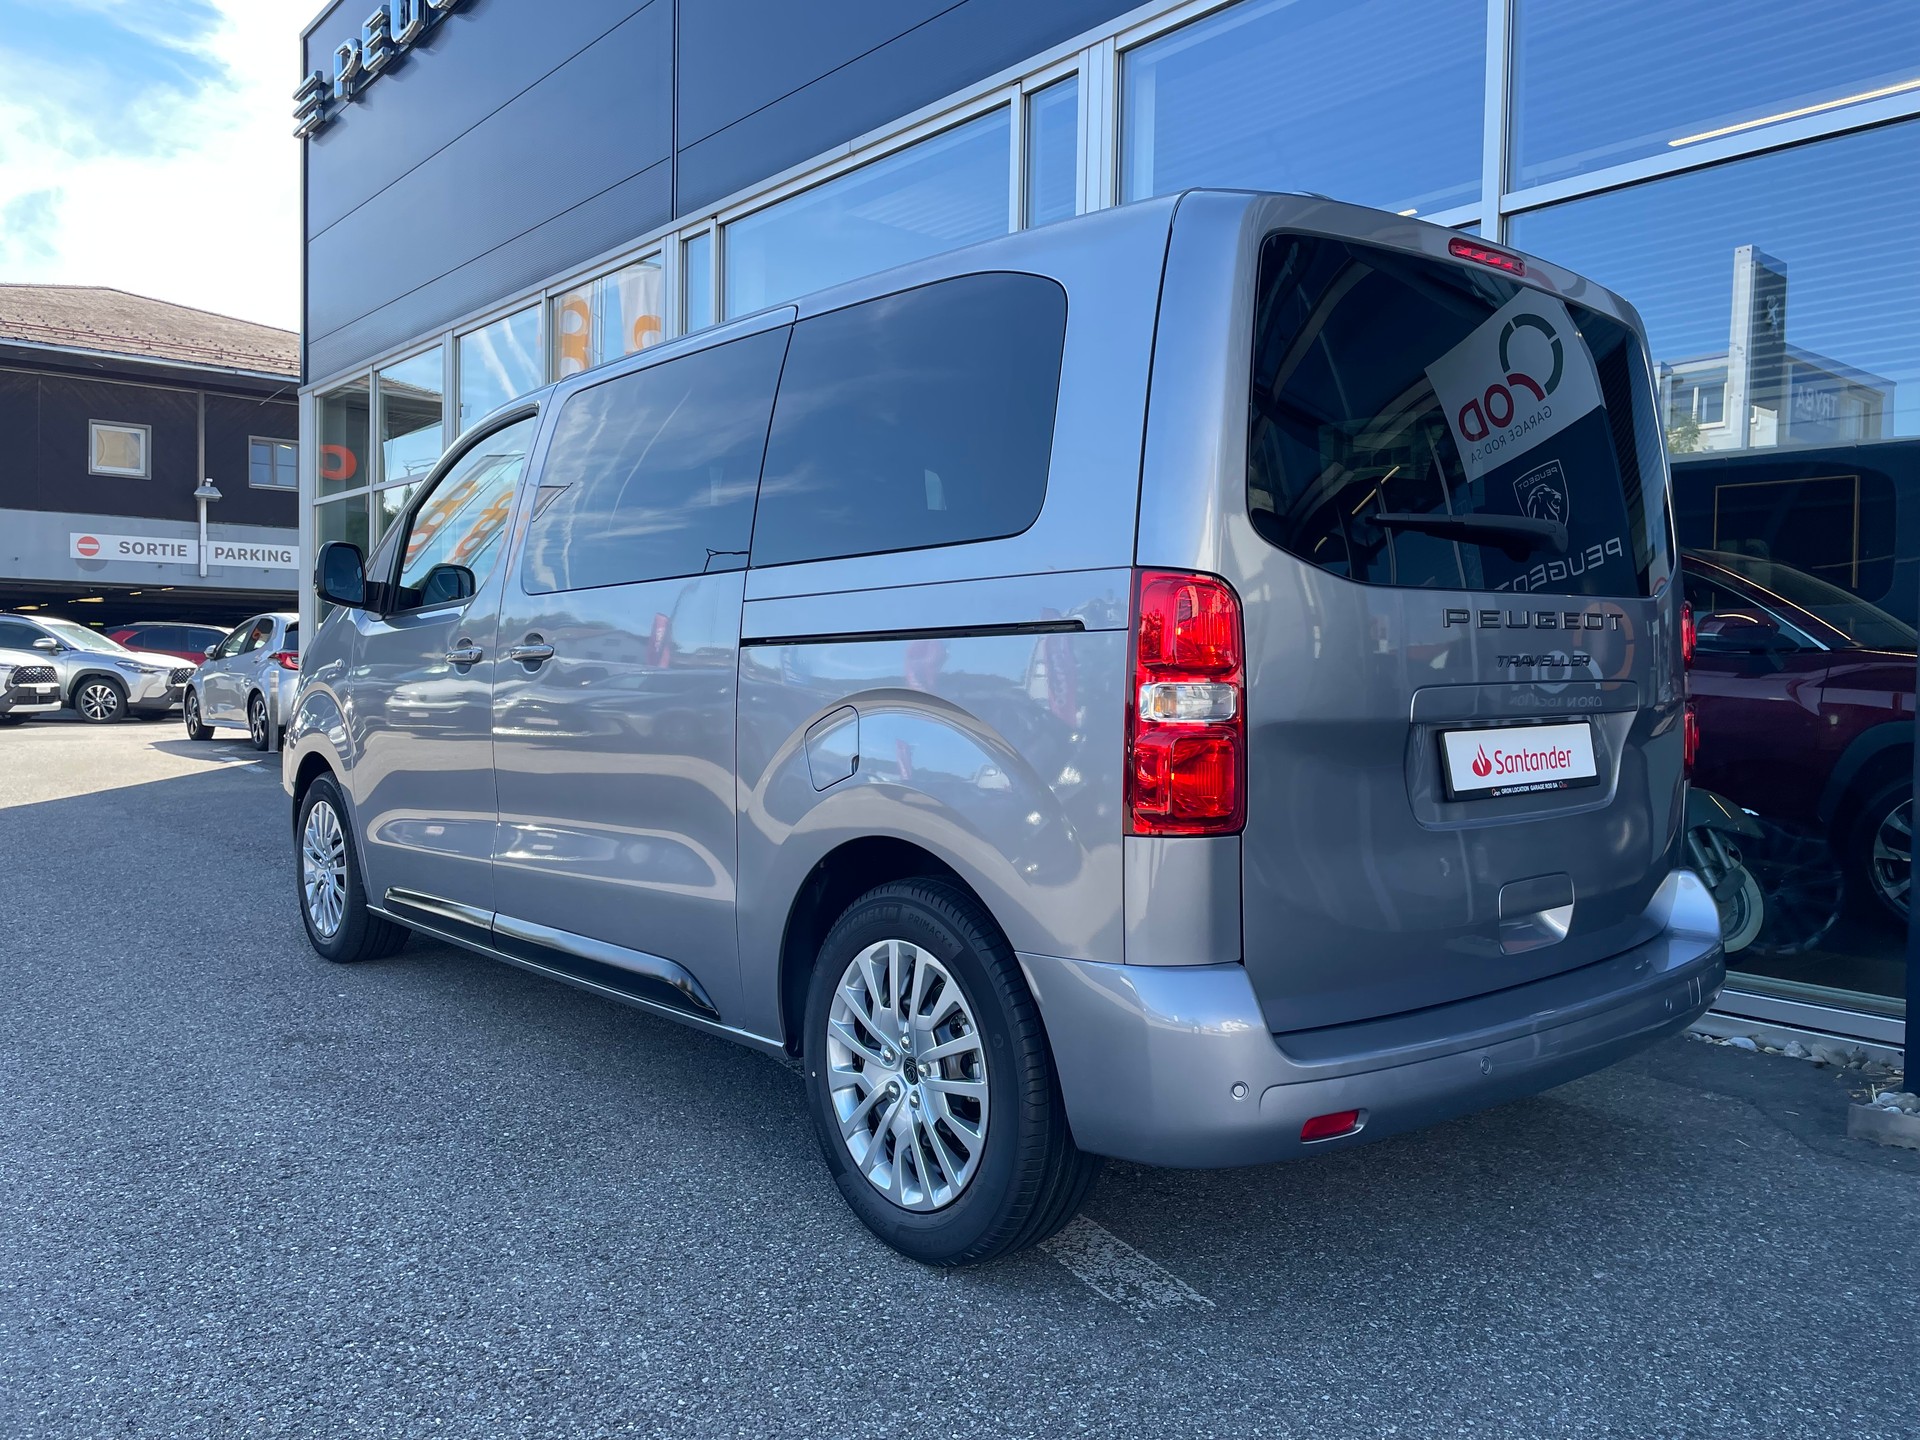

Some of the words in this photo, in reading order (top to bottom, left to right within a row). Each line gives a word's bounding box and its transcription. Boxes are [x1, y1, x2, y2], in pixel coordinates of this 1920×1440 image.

[334, 0, 459, 100] PEU
[118, 540, 188, 558] SORTIE
[214, 546, 293, 564] PARKING
[1442, 608, 1624, 632] PEUGEOT
[1497, 655, 1592, 668] TRAVELLER
[1494, 746, 1572, 775] Santander
[907, 912, 949, 943] PRIMACY
